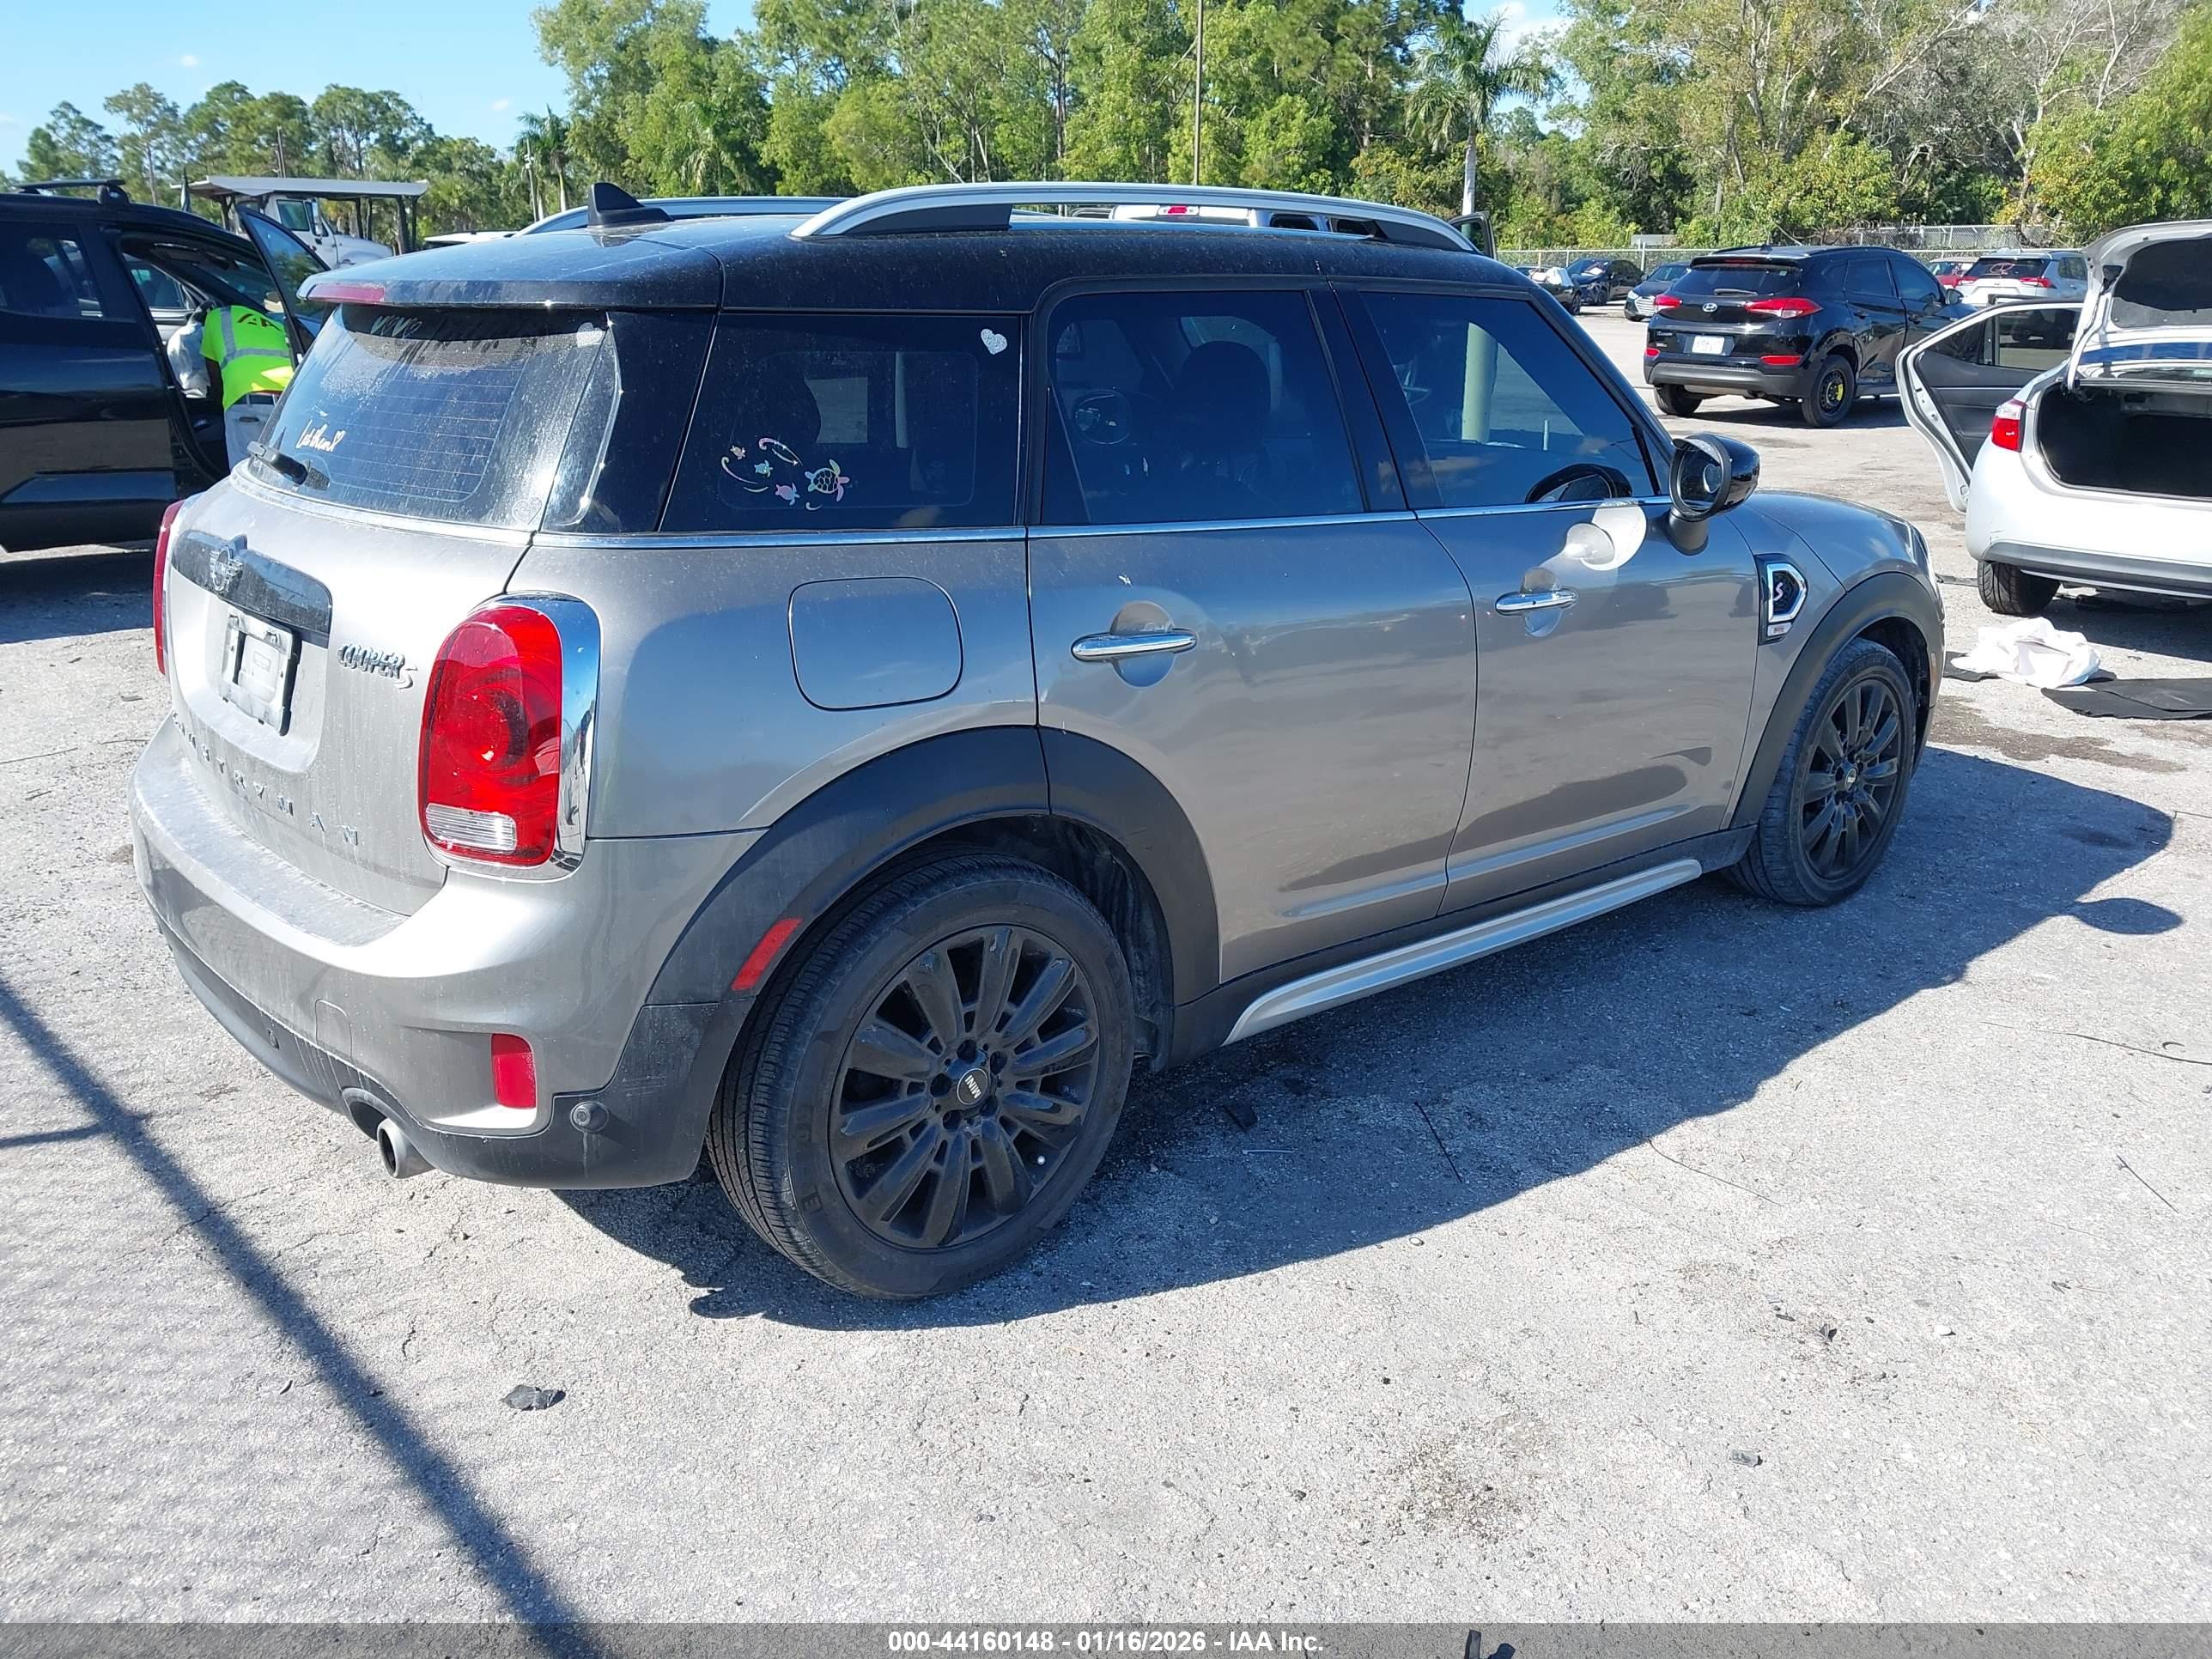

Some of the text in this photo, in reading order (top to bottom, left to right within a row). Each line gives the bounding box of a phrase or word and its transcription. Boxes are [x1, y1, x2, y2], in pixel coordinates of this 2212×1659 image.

[1772, 581, 1784, 601] S
[337, 644, 418, 691] COOPER S
[964, 1074, 981, 1099] MINI
